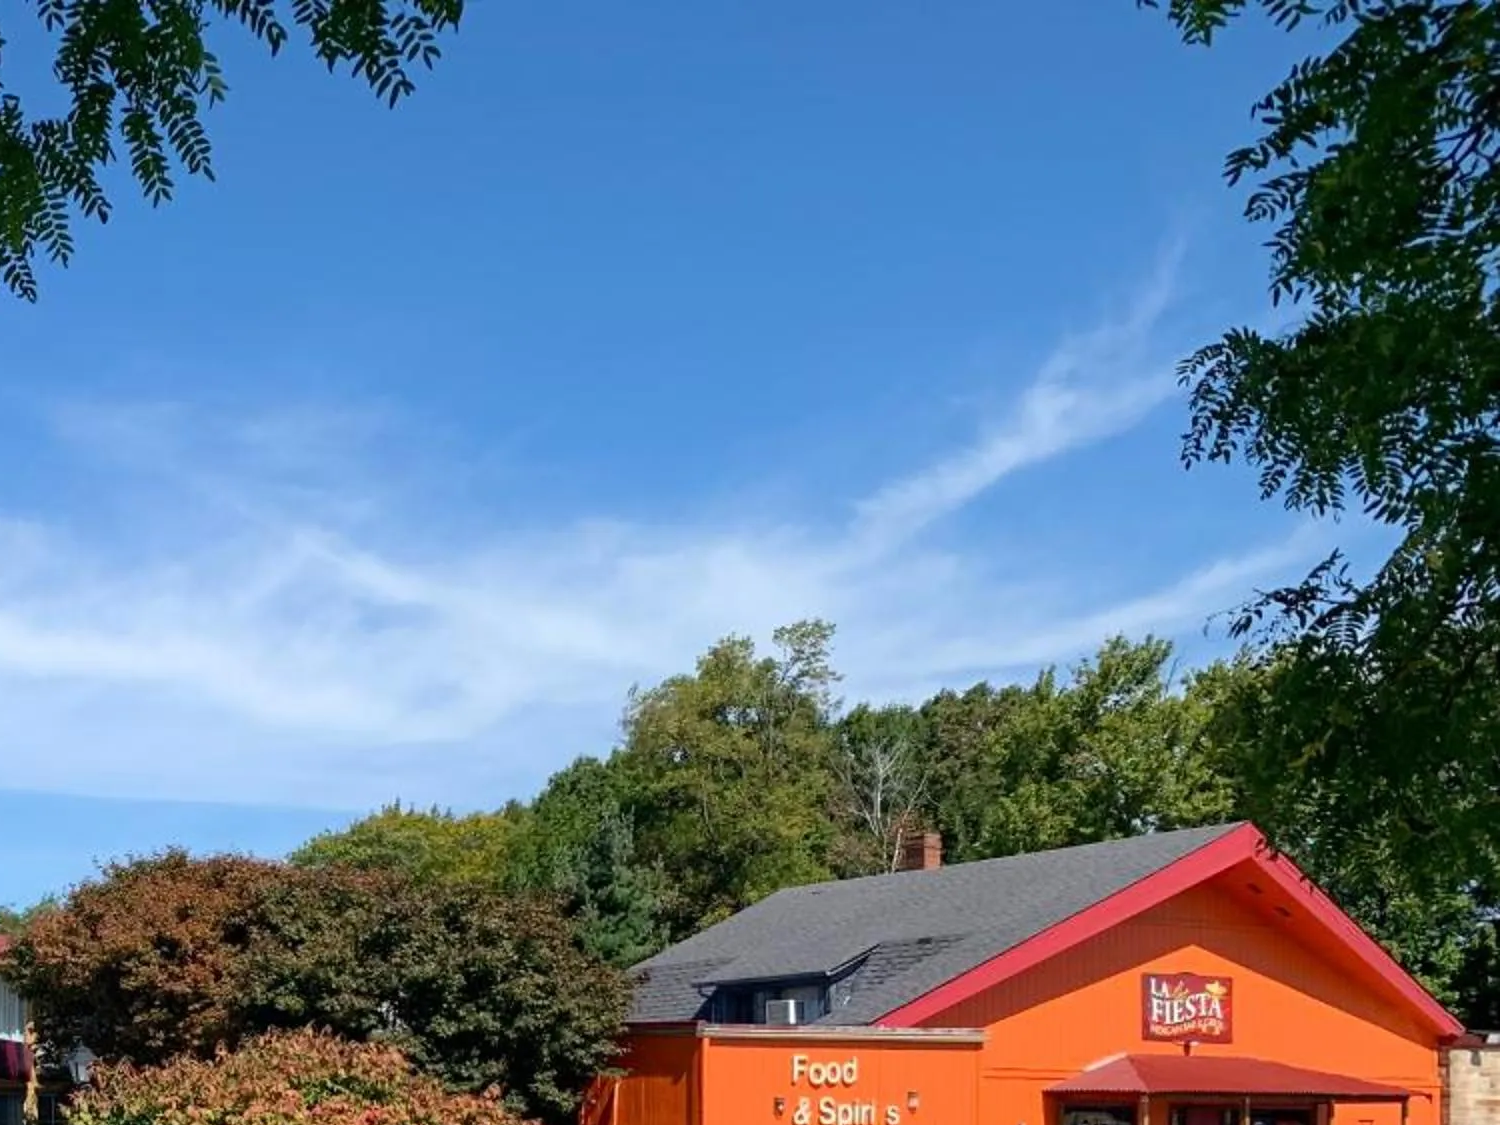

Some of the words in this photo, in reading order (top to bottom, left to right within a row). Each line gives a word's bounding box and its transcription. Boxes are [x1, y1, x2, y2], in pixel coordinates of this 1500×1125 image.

[1150, 977, 1170, 998] LA
[1152, 992, 1223, 1024] FIESTA
[791, 1055, 858, 1086] Food
